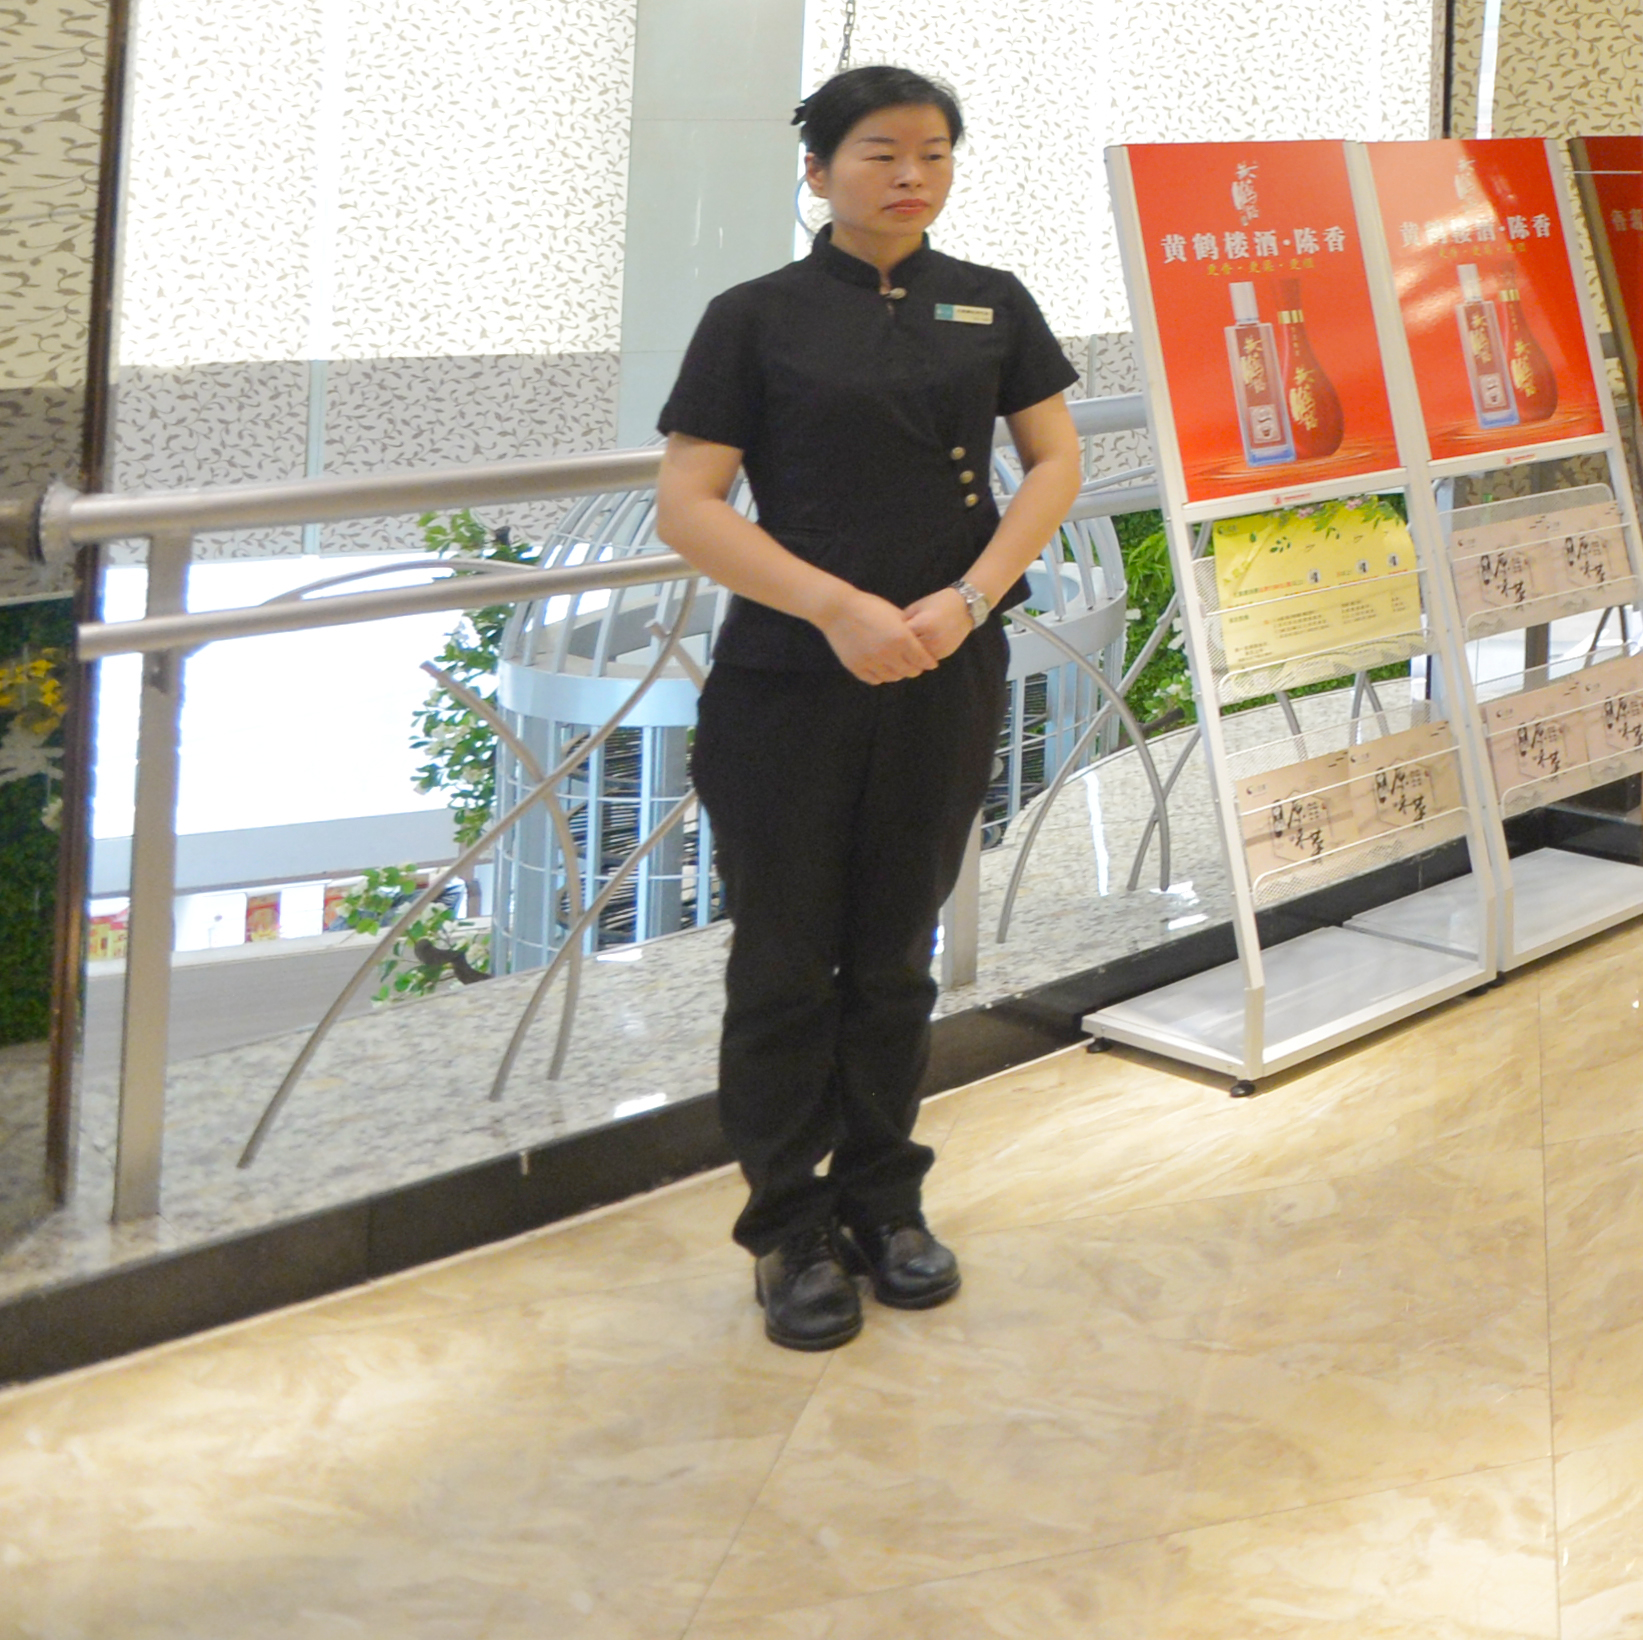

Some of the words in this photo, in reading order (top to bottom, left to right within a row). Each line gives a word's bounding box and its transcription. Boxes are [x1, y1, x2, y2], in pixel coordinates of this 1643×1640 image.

[1160, 224, 1347, 265] 黄鹤楼酒·陈香
